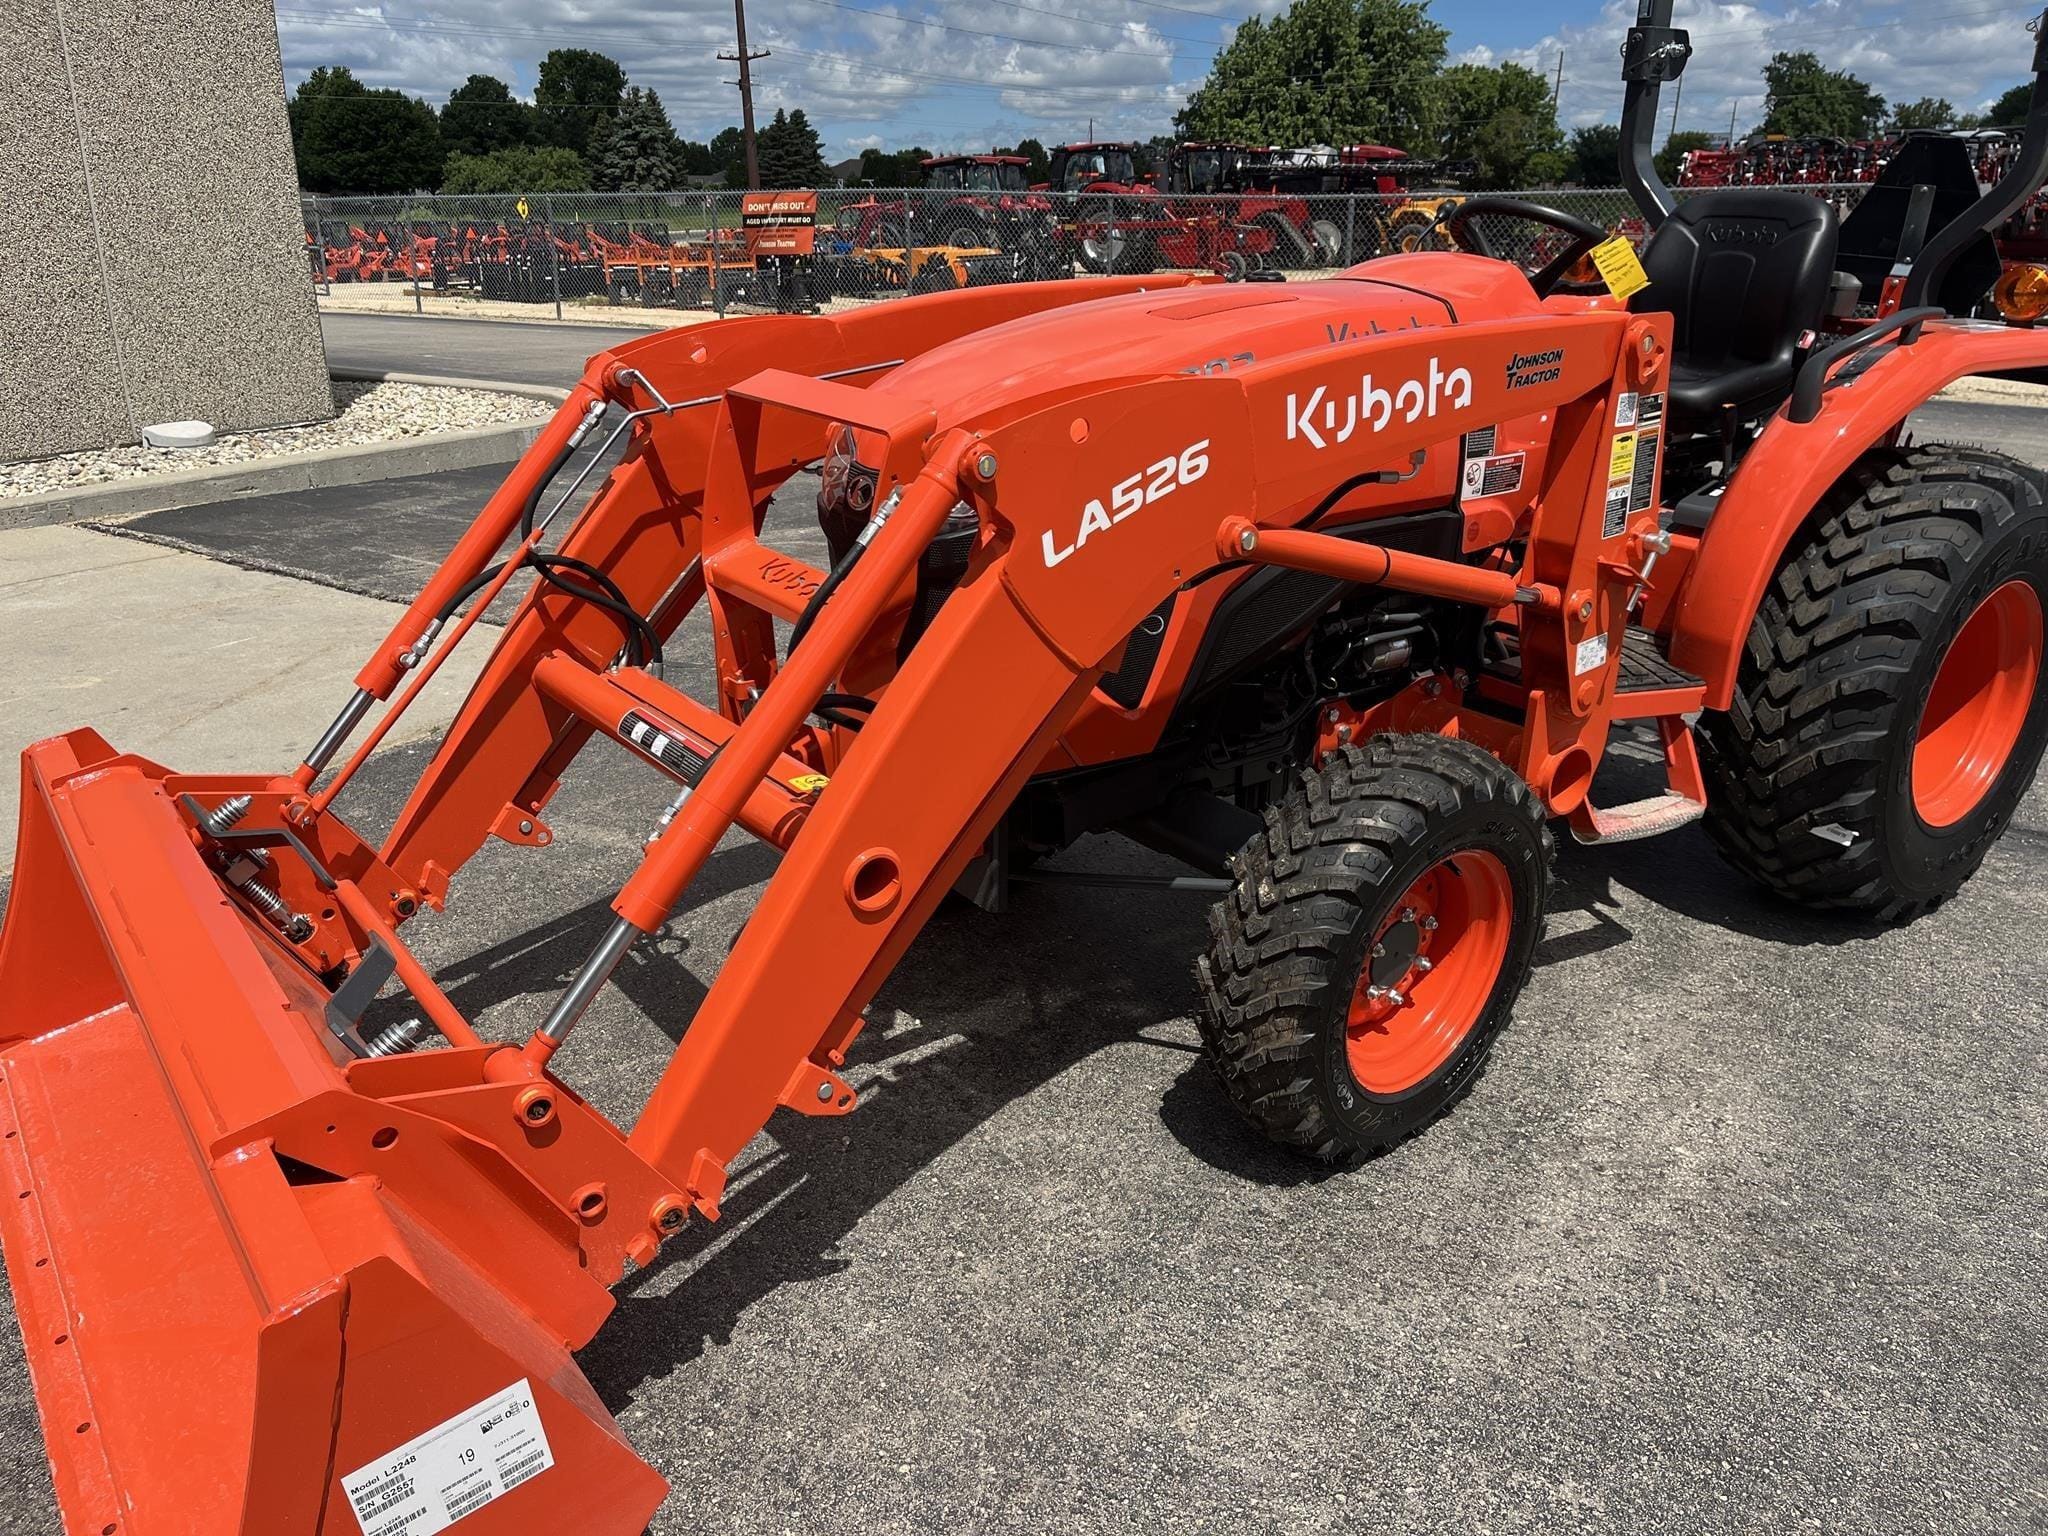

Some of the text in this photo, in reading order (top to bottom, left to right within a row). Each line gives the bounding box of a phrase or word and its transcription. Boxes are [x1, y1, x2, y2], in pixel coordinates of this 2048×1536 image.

[748, 203, 771, 212] DON'T
[772, 202, 788, 211] MISS
[789, 201, 805, 210] OUT
[1506, 349, 1564, 371] JOHNSON
[1506, 367, 1560, 390] TRACTOR
[1286, 357, 1472, 449] Kubota
[1042, 438, 1210, 568] LA526
[458, 1448, 475, 1466] 19
[350, 1455, 417, 1495] Model L2248
[358, 1477, 414, 1514] S/N G2557
